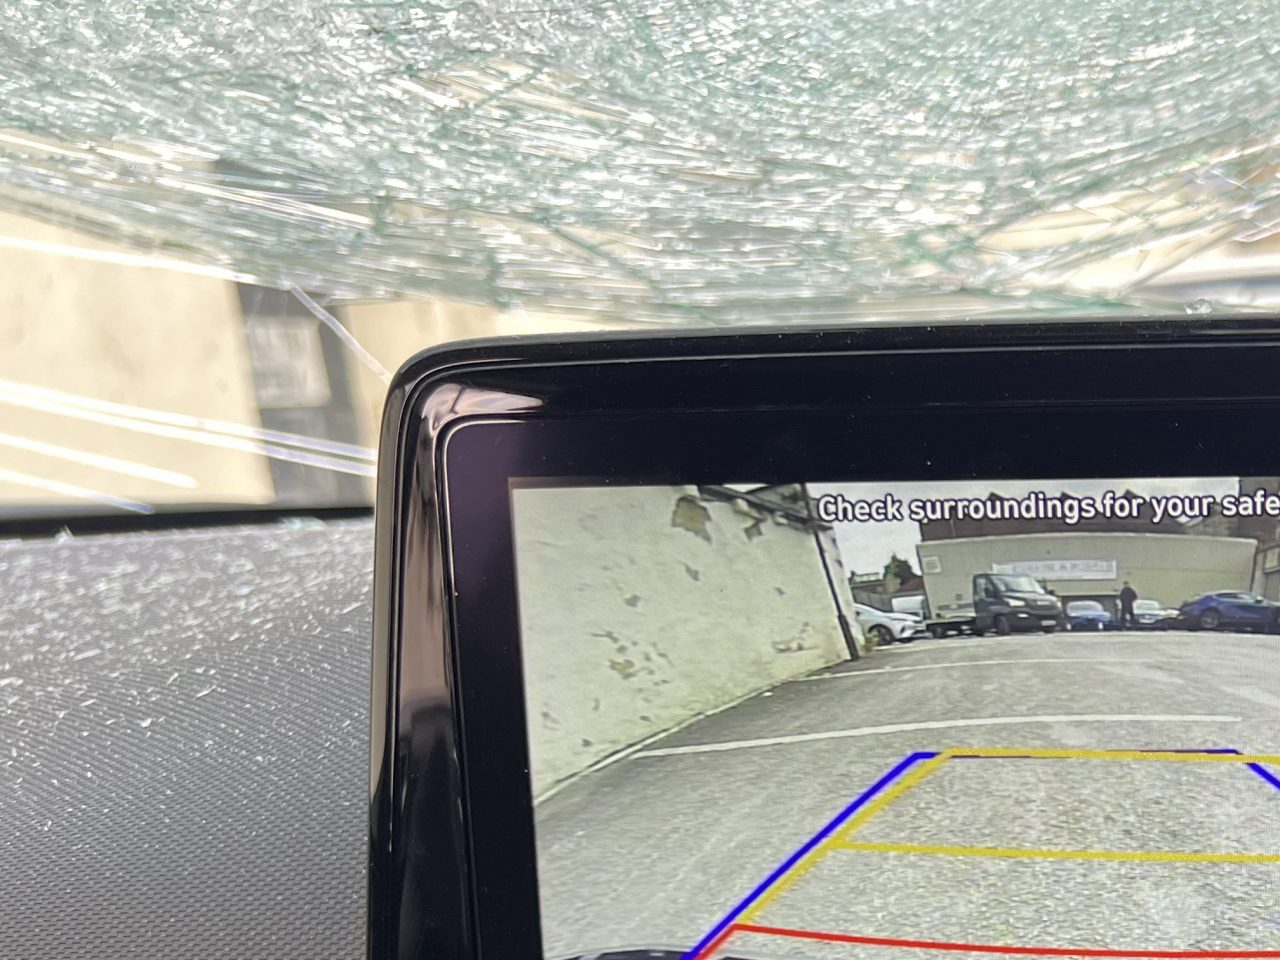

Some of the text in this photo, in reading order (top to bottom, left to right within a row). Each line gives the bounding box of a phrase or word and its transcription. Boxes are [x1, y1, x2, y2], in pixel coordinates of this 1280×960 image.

[818, 495, 902, 521] Check
[908, 493, 1096, 524] surroundings
[1101, 493, 1146, 519] for
[1151, 496, 1214, 523] your
